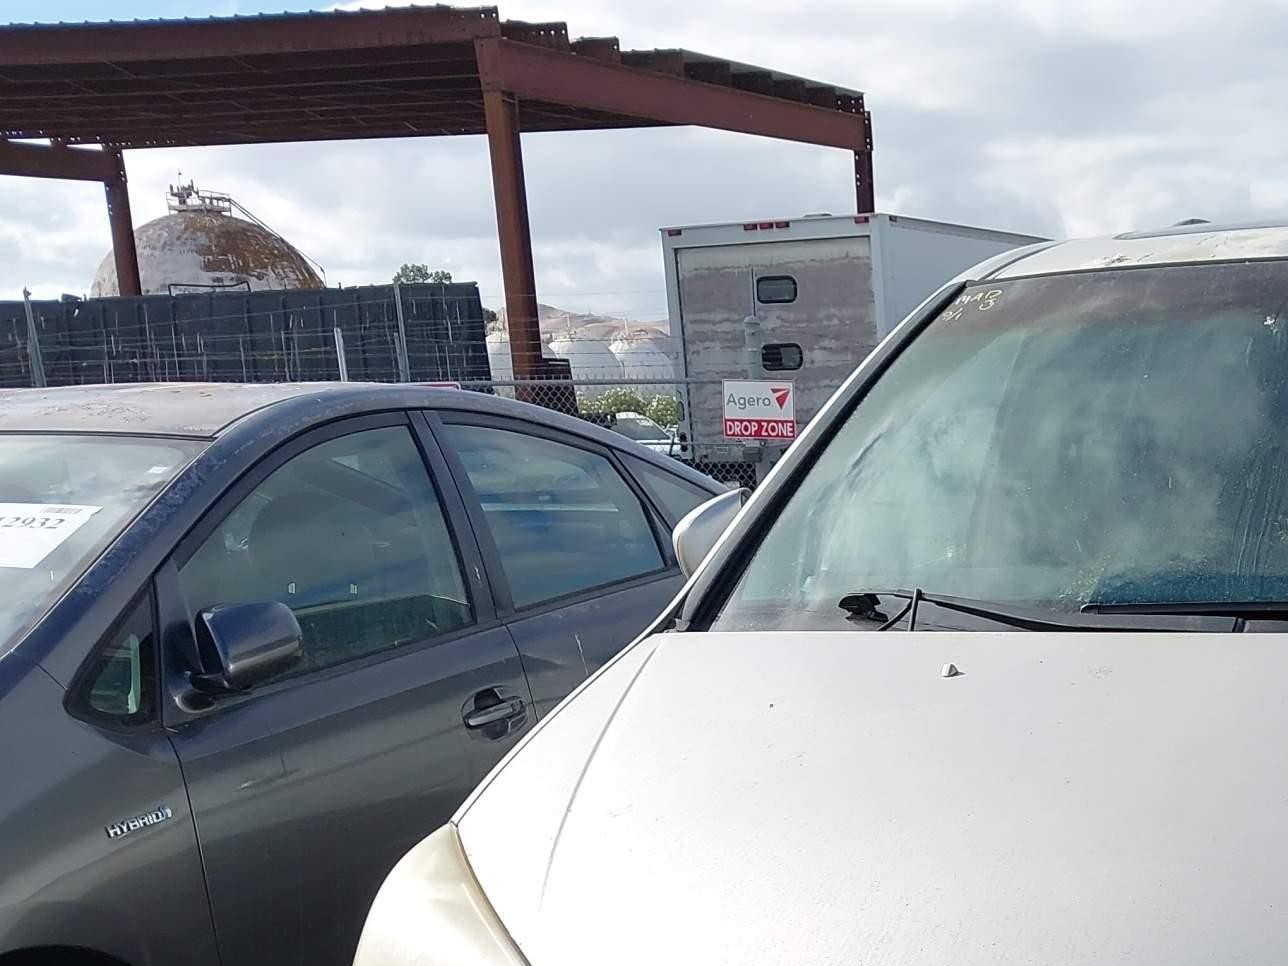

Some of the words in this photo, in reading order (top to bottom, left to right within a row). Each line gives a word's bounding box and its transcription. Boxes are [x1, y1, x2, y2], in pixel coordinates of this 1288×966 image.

[726, 392, 772, 410] Agero
[726, 421, 758, 436] DROP
[761, 422, 794, 437] ZONE
[106, 811, 164, 838] HYBRID
